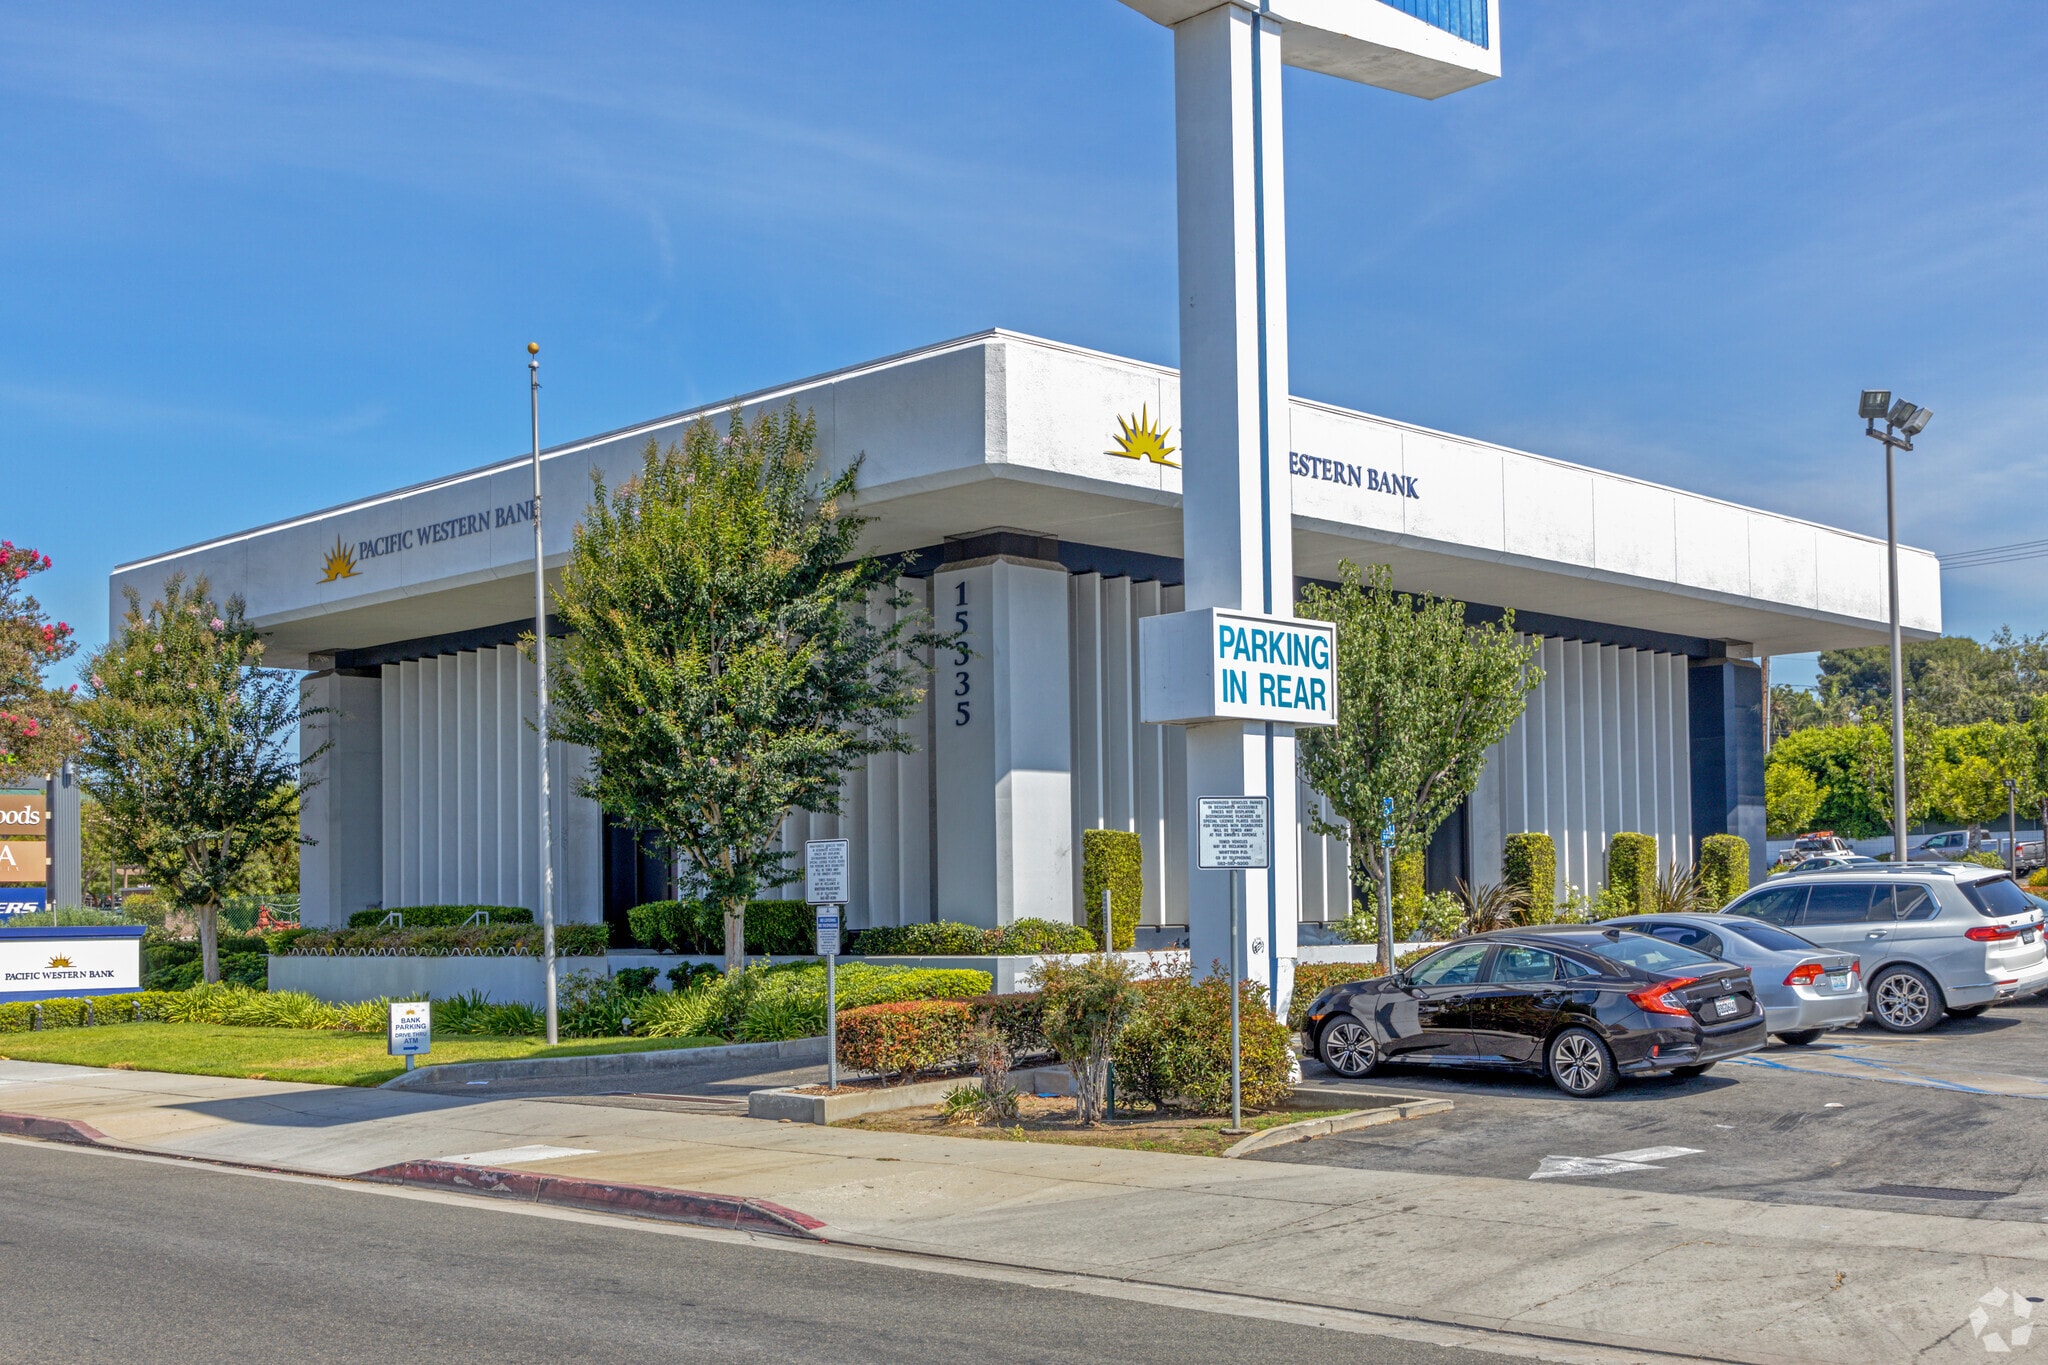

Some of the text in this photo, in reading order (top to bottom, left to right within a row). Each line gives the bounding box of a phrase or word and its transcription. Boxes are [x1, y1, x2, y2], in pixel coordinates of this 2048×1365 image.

[1289, 451, 1420, 499] ESTERN BANK
[359, 530, 413, 560] PACIFIC
[417, 511, 490, 546] WESTERN
[954, 581, 971, 726] 15335
[1219, 625, 1329, 670] PARKING
[1222, 668, 1326, 711] IN REAR
[5, 970, 114, 981] PACIFIC WESTERN BANK
[395, 1023, 427, 1031] PARKING
